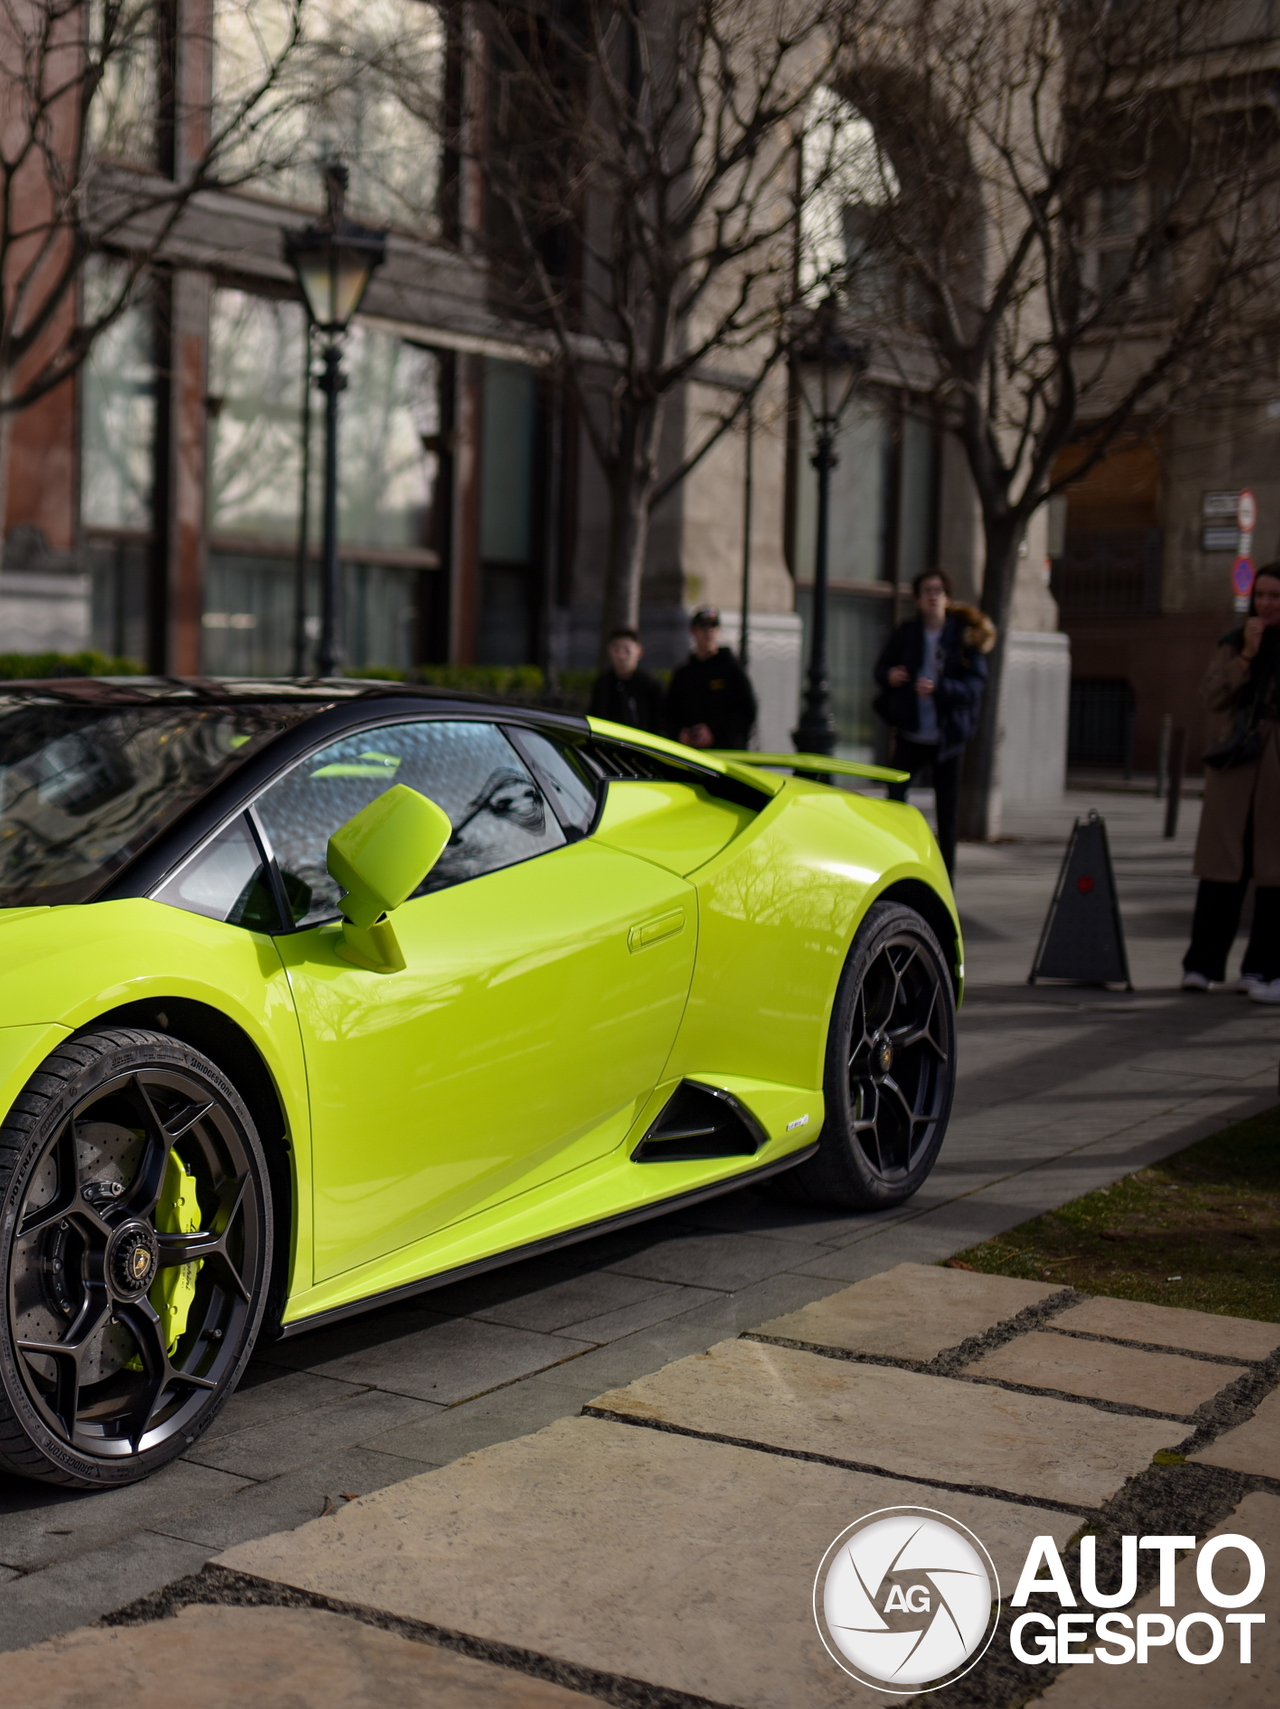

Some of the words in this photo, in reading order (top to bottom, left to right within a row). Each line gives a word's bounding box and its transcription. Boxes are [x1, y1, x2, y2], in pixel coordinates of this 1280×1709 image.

[190, 1058, 233, 1098] BRIDGESTONE
[9, 1142, 38, 1206] POTENZA
[40, 1103, 61, 1132] SPORT
[44, 1440, 95, 1476] BRIDGESTONE
